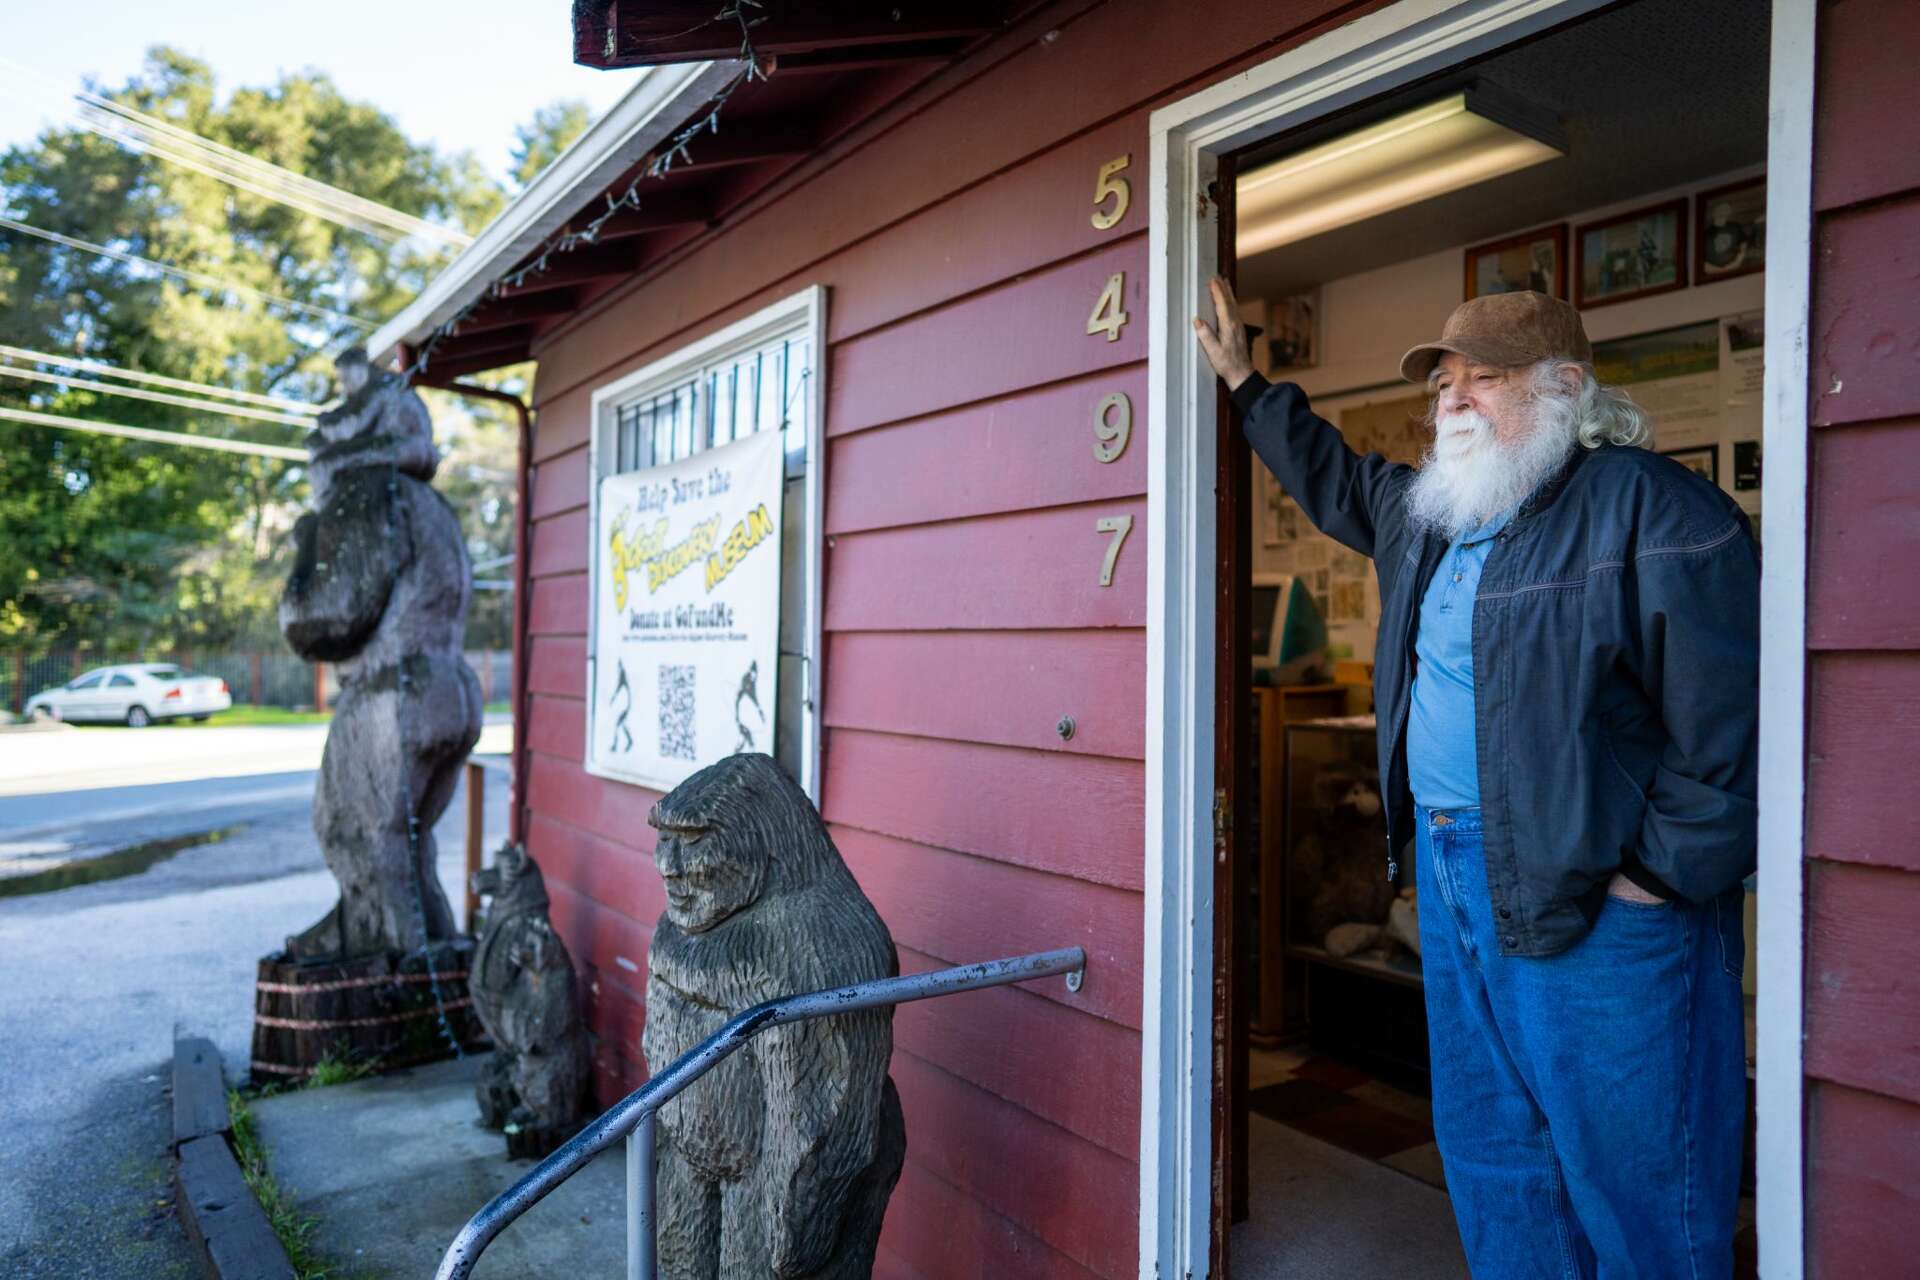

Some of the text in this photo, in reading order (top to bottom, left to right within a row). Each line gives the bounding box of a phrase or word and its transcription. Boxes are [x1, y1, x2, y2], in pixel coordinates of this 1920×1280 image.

[638, 467, 731, 513] Help Save the
[704, 503, 774, 595] MUSEUM
[630, 601, 733, 629] Donate at GoFundMe
